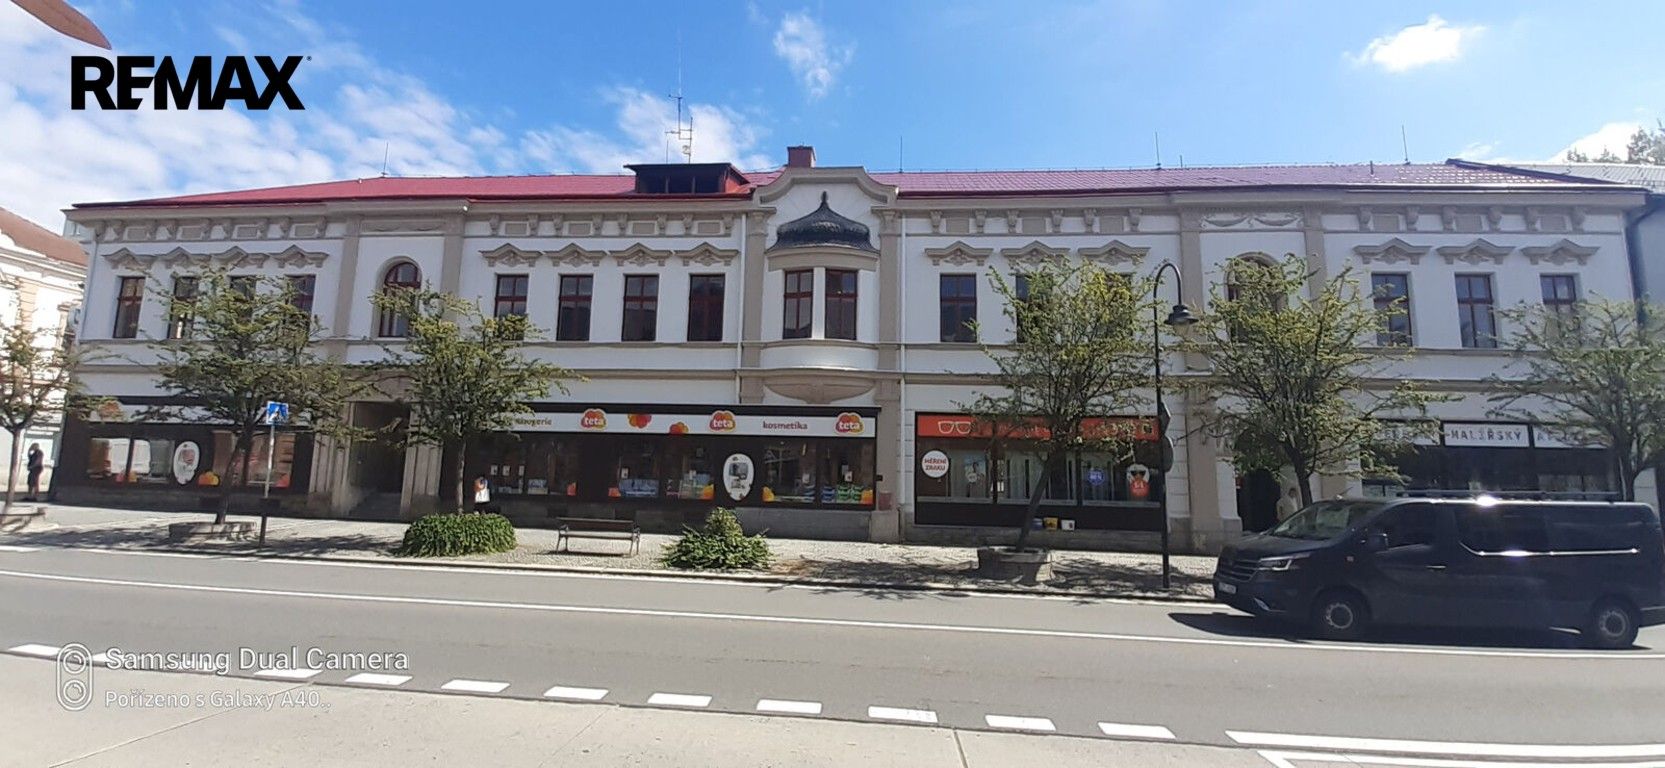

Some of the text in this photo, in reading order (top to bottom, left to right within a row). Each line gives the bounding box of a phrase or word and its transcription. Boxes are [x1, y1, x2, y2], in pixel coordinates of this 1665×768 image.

[584, 415, 605, 426] teta
[713, 418, 733, 428] teta
[762, 420, 808, 431] kosmetika
[839, 421, 861, 431] teta
